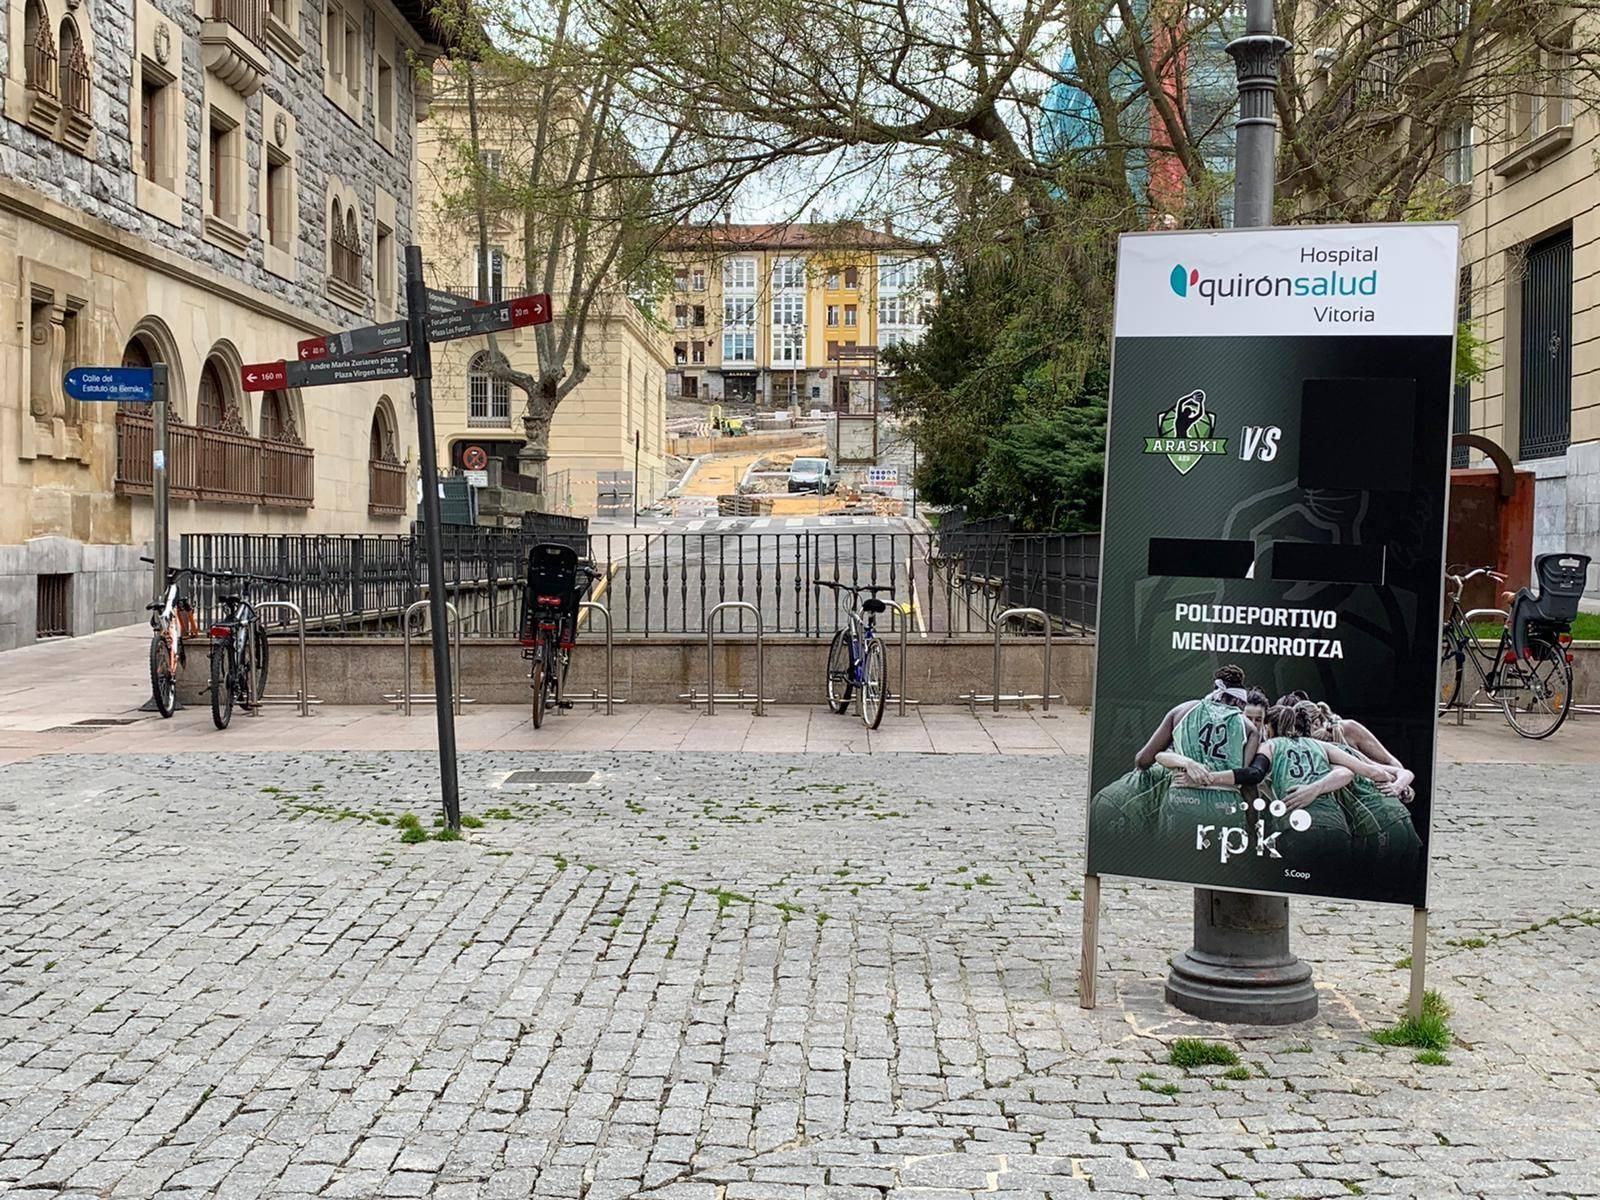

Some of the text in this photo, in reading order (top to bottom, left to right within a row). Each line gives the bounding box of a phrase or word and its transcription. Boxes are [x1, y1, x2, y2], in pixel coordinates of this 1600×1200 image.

[1300, 246, 1379, 266] Hospital
[1199, 270, 1377, 306] quirónsalud
[448, 315, 462, 324] plaza
[1313, 306, 1375, 323] Vitoria
[432, 325, 471, 337] Plaza Los Fueros
[310, 356, 399, 371] Andre Maria Zuriaren plaza
[82, 374, 113, 383] Calle del
[261, 372, 283, 381] 160 m
[334, 366, 400, 379] Plaza Virgen Blanca
[82, 384, 108, 393] Estatuto
[1152, 440, 1218, 452] ARASKI
[1239, 425, 1282, 462] VS
[1175, 603, 1338, 630] POLIDEPORTIVO
[1171, 631, 1344, 660] MENDIZORROTZA
[1198, 720, 1228, 760] 42
[1287, 748, 1321, 779] 31
[1195, 818, 1283, 864] rpk
[1284, 869, 1311, 880] S.Coop
